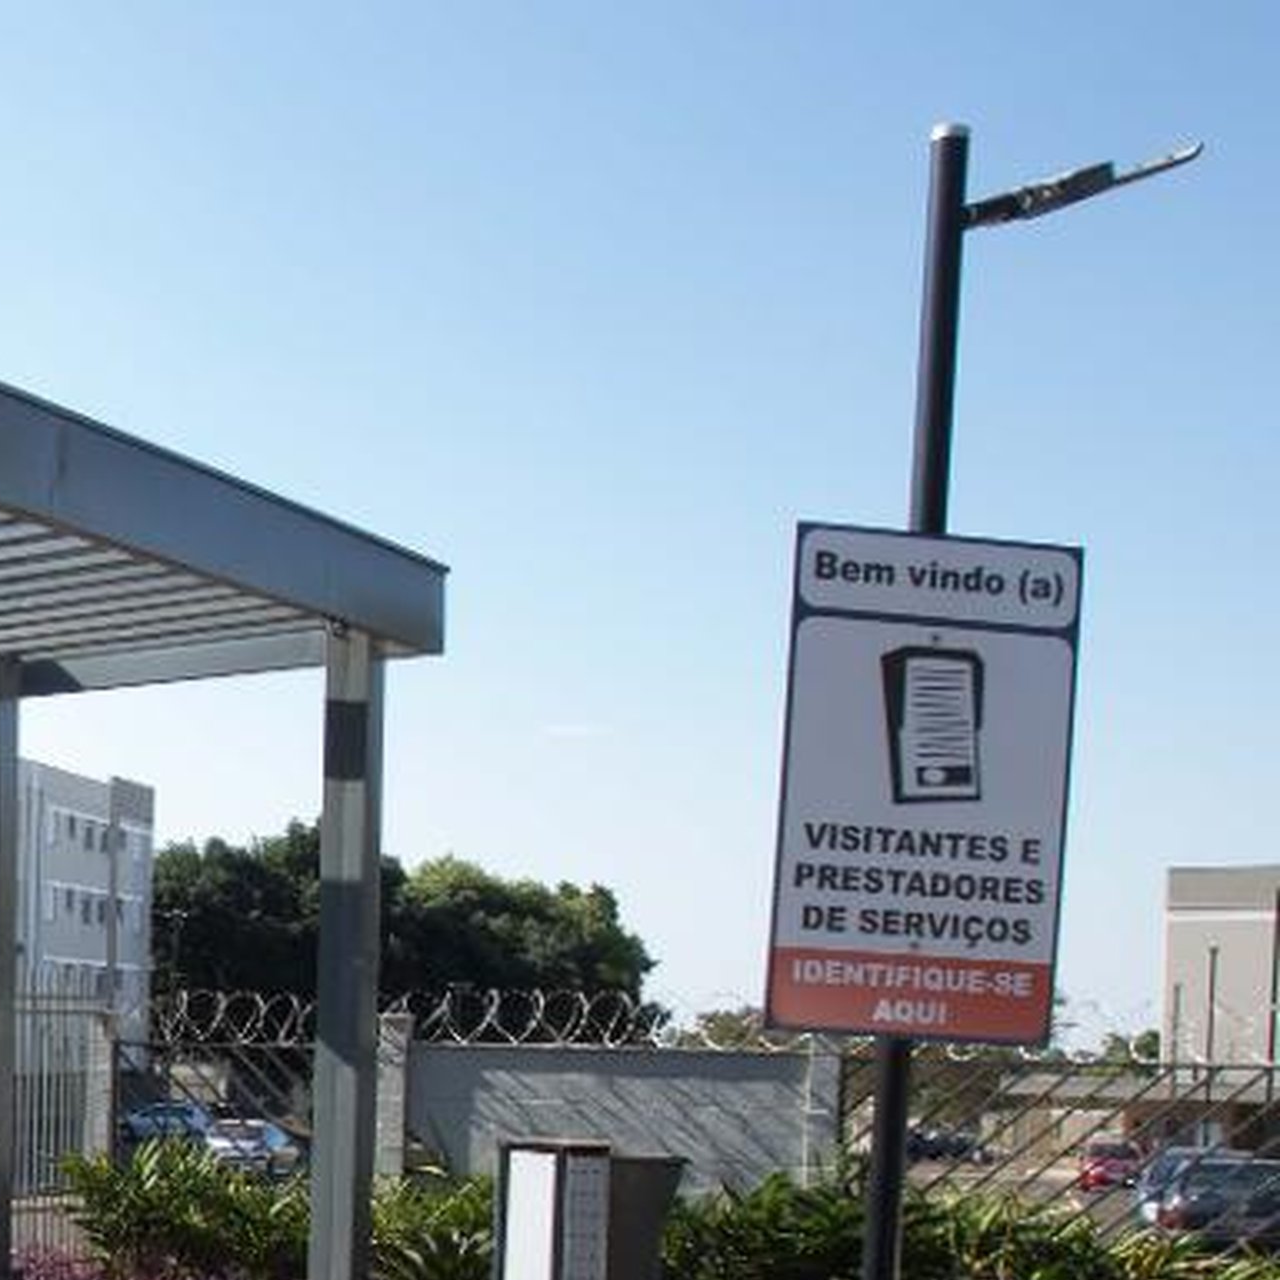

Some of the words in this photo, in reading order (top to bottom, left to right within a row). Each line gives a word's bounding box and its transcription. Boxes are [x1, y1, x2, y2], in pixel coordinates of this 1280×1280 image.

[815, 551, 896, 587] Bem
[907, 561, 1006, 596] vindo
[1018, 569, 1065, 607] (a)
[804, 822, 1009, 863] VISITANTES
[1021, 838, 1042, 866] E
[793, 863, 1046, 904] PRESTADORES
[801, 905, 847, 933] DE
[858, 909, 1032, 948] SERVIÇOS
[793, 958, 1034, 997] IDENTIFIQUE-SE
[871, 1000, 947, 1024] AQUI
